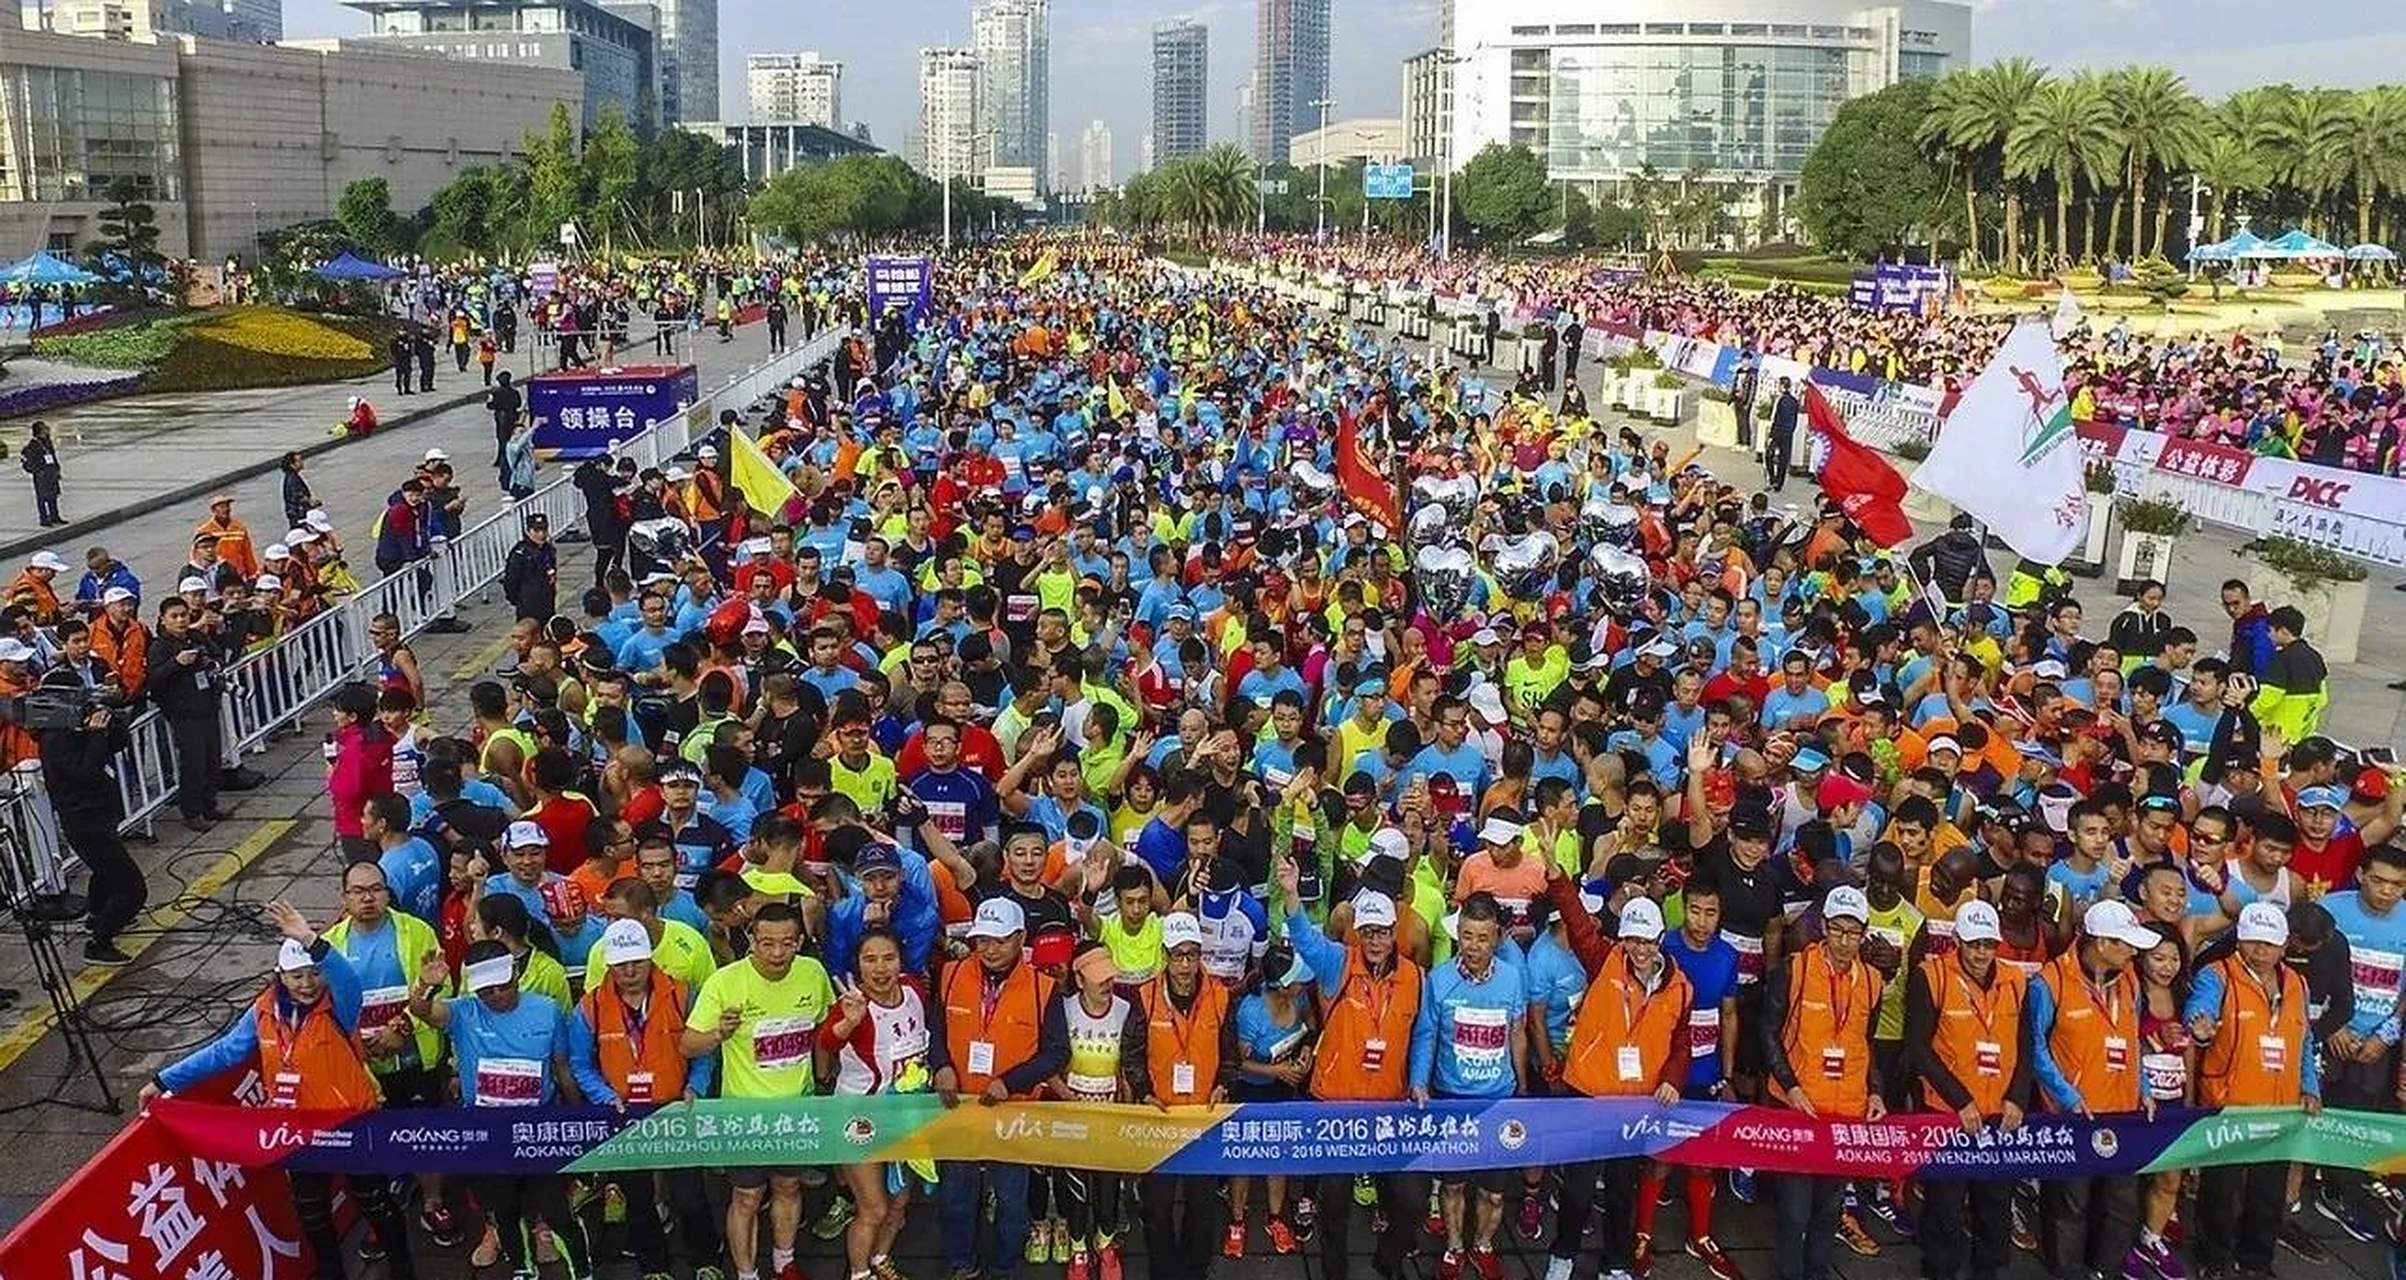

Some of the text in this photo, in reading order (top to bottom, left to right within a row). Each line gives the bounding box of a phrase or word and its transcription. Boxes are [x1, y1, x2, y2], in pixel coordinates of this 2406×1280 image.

[560, 406, 636, 430] 领操台
[2164, 447, 2241, 484] 公益体彩
[389, 1126, 461, 1142] AOKANG
[512, 1111, 821, 1143] 奥康国际 2016 温州马拉松
[1221, 1113, 1480, 1143] 奥康国际 2016 温州马拉松
[1732, 1123, 1792, 1143] AOKANG
[1831, 1122, 1911, 1147] 奥康国际
[1920, 1124, 1970, 1148] 2016
[514, 1137, 820, 1158] AOKANG 2016 WENZHOU MARATHON
[1221, 1141, 1480, 1159] AOKANG 2016 WENZHOU MARATHON
[1835, 1149, 2077, 1165] AOKANG 2016 WENZHOU MARATHON
